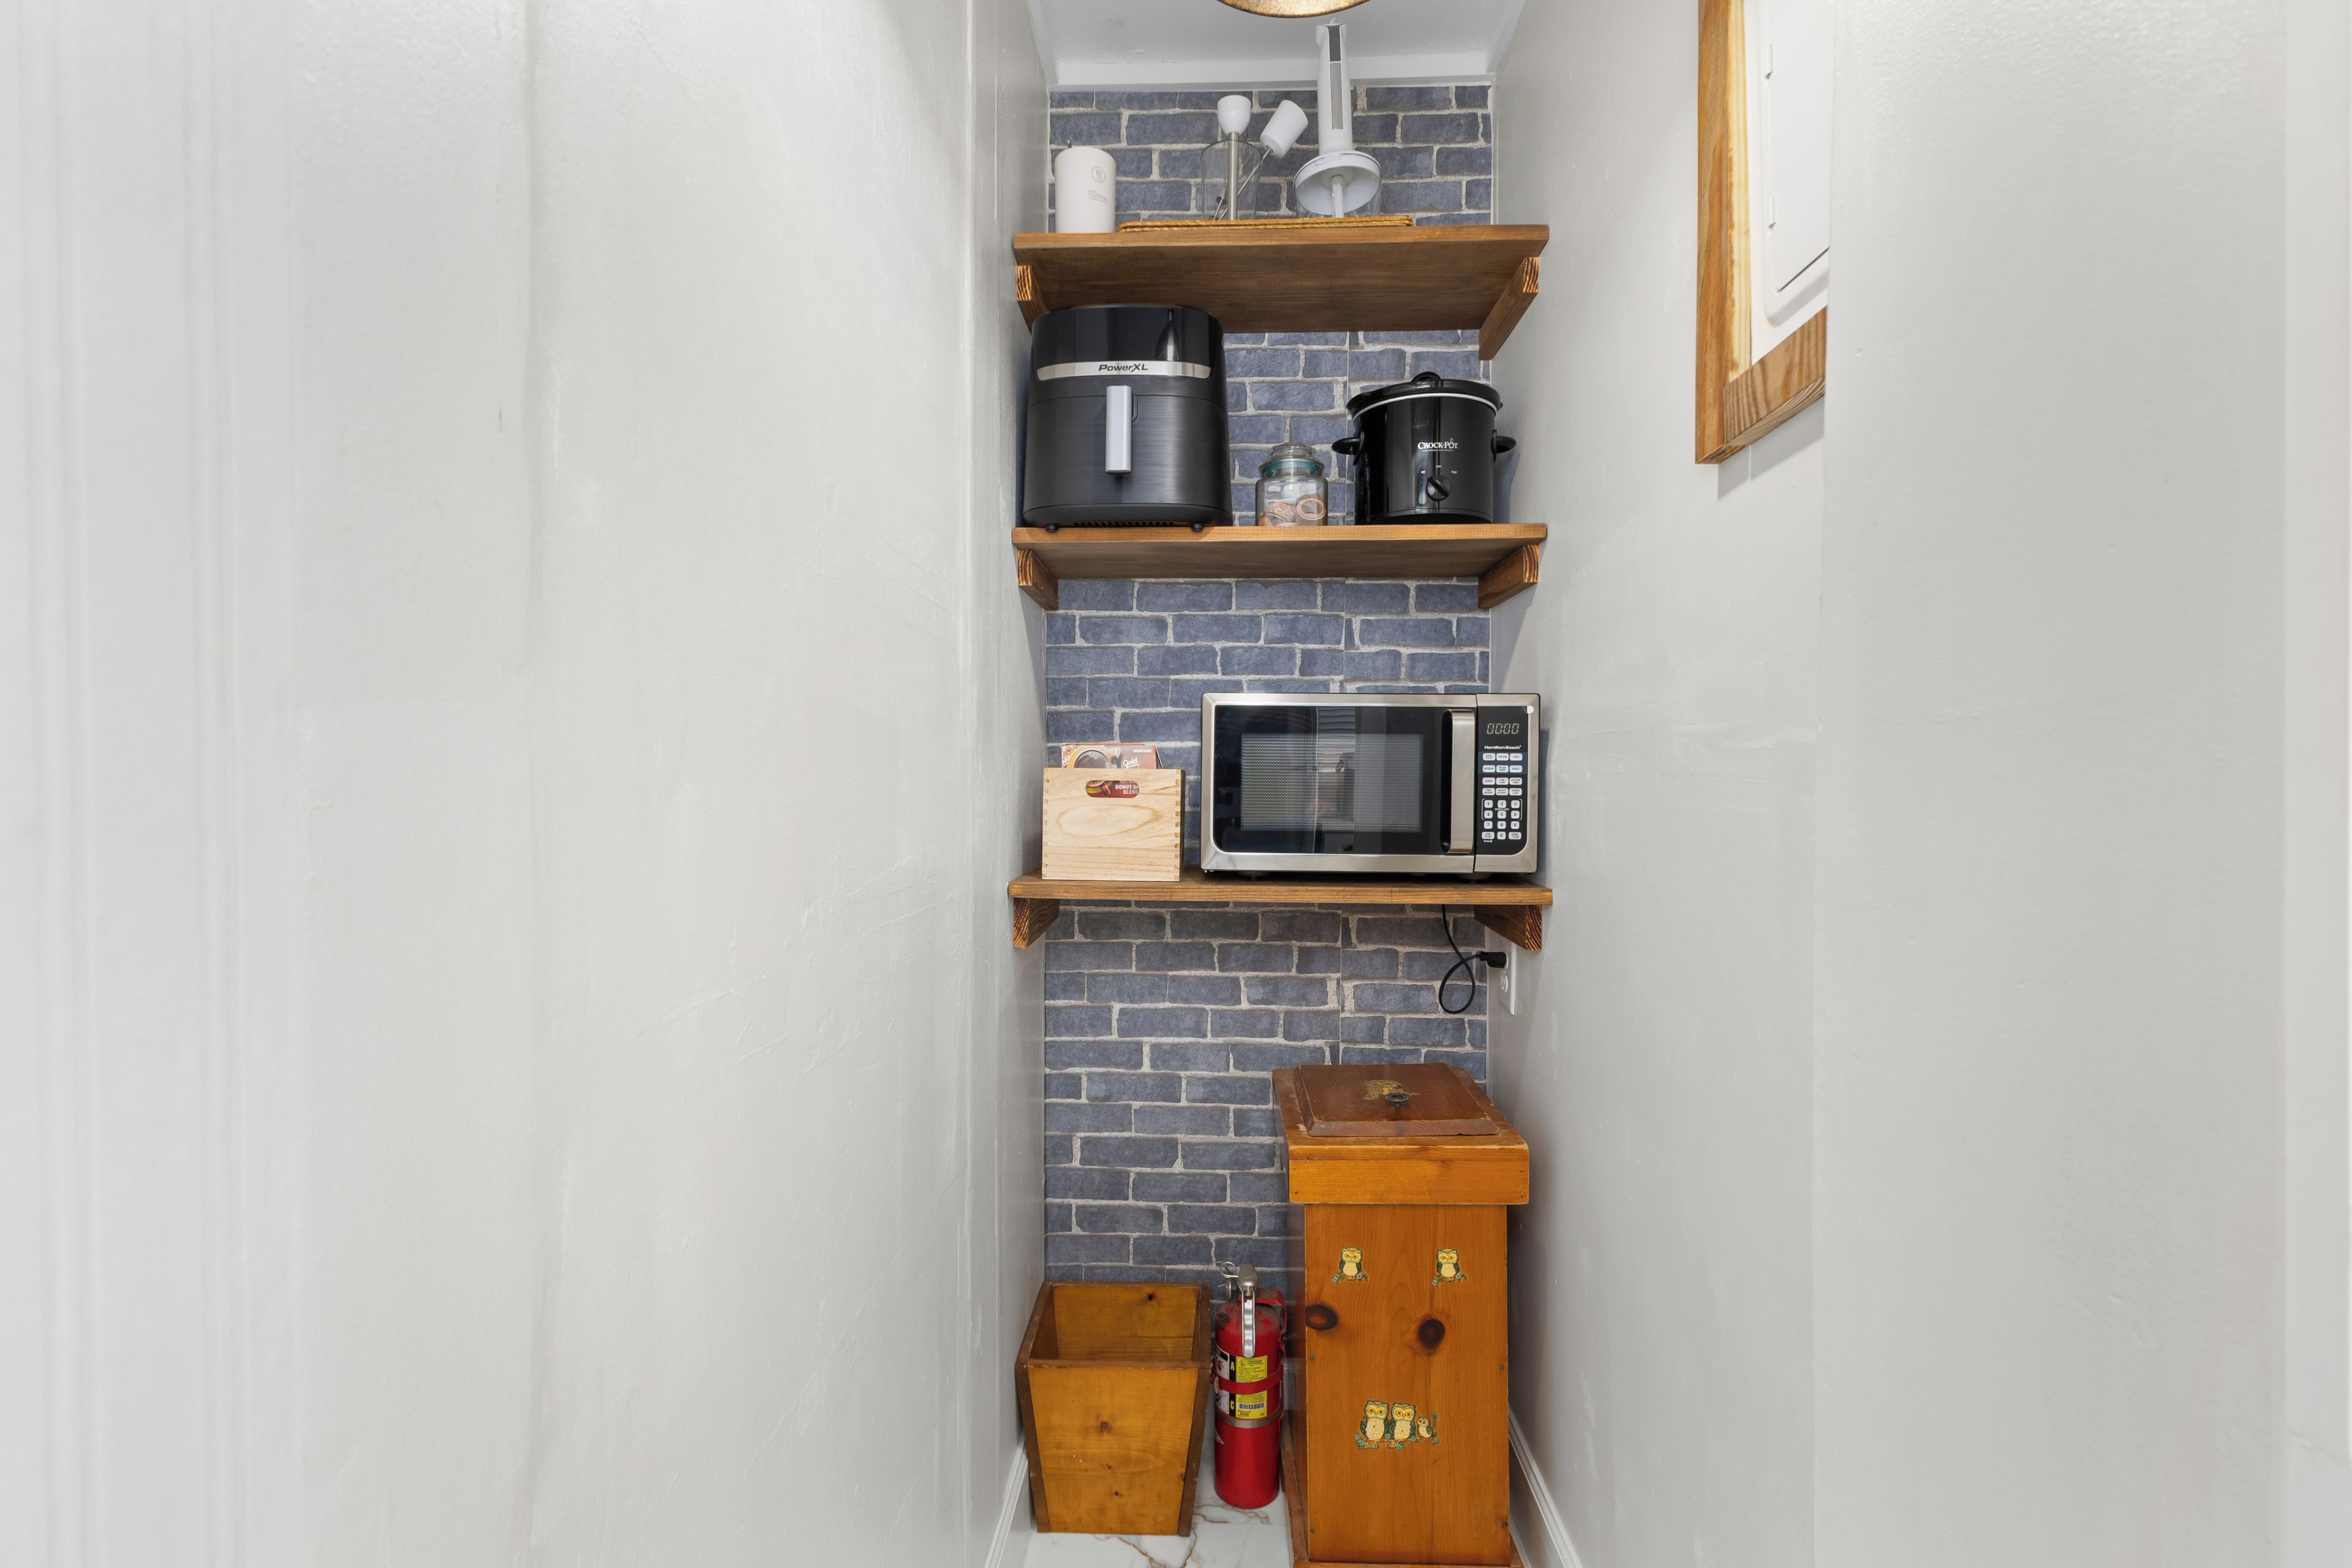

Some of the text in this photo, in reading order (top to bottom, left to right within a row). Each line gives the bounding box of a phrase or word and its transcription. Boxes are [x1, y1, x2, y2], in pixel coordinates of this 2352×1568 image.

[1098, 363, 1148, 373] PowerXL
[1123, 757, 1139, 768] Gold
[1231, 1362, 1235, 1371] A
[1230, 1401, 1234, 1409] C
